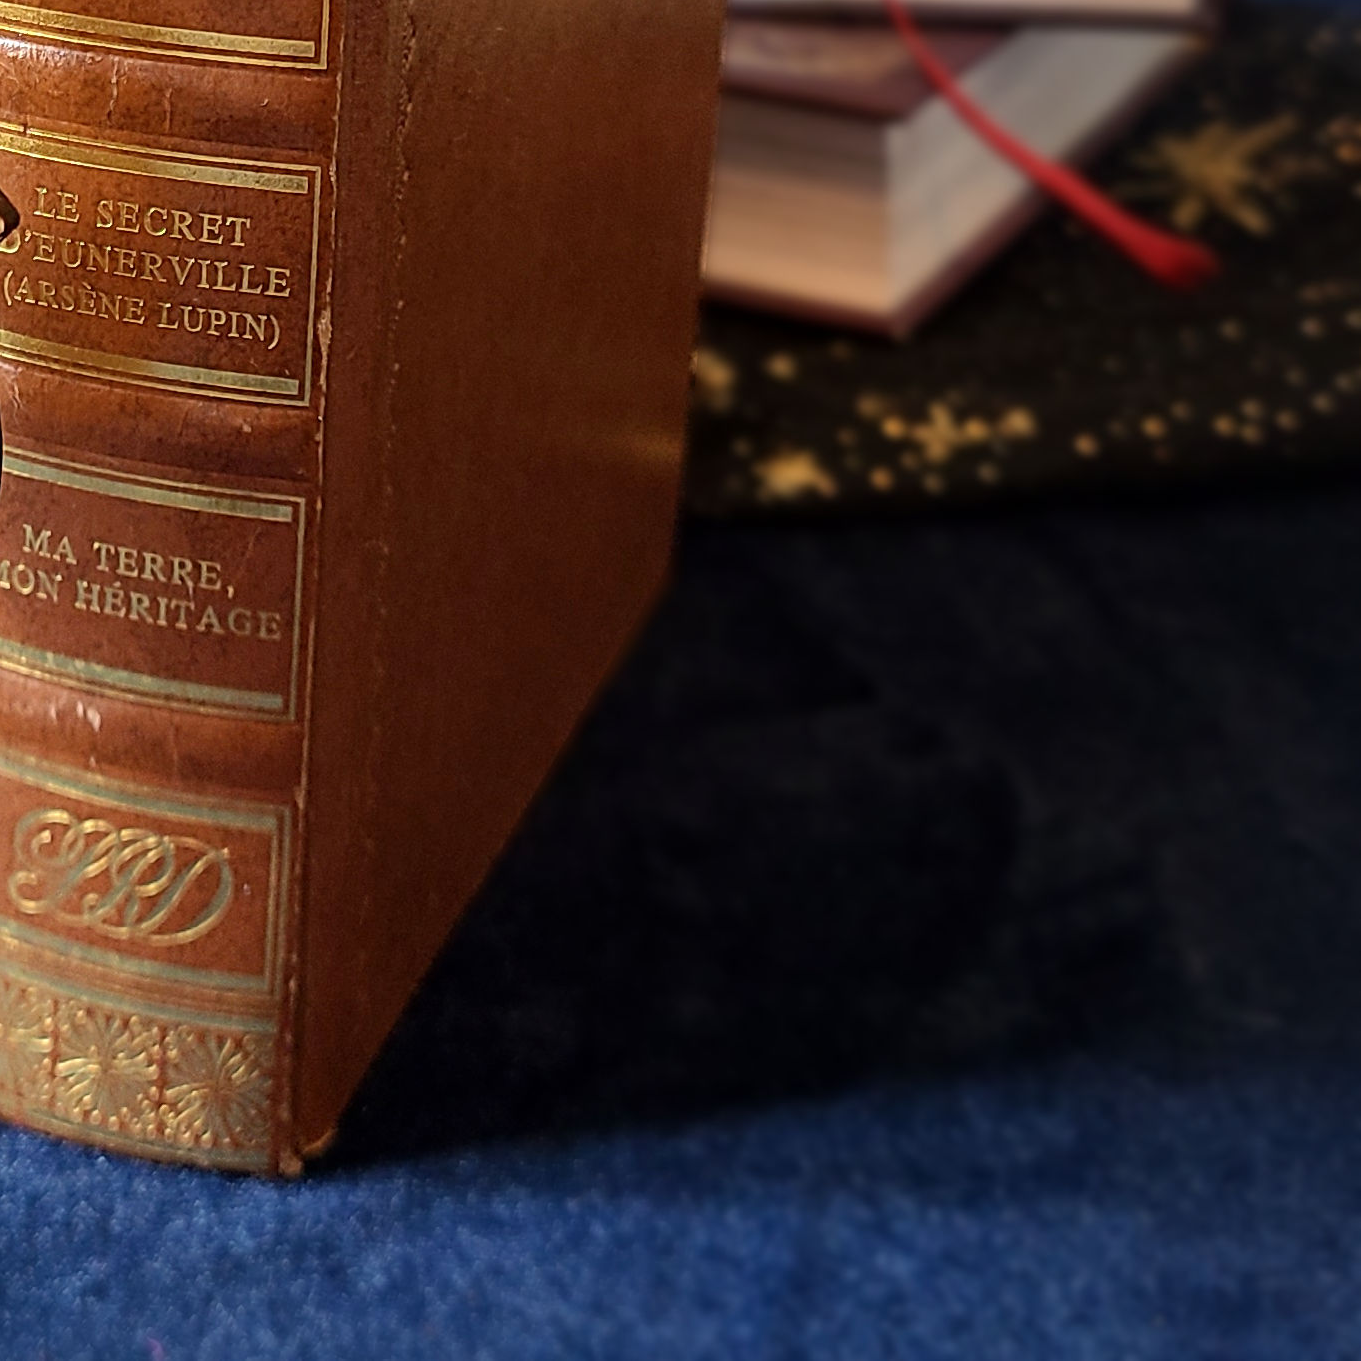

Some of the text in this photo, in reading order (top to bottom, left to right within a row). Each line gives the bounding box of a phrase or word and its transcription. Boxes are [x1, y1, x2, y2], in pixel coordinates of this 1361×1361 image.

[33, 186, 251, 248] LE SECRET
[2, 270, 281, 350] (ARSÈNE LUPIN)
[22, 523, 236, 599] MA TERRE,
[74, 580, 283, 640] HÉRITAGE
